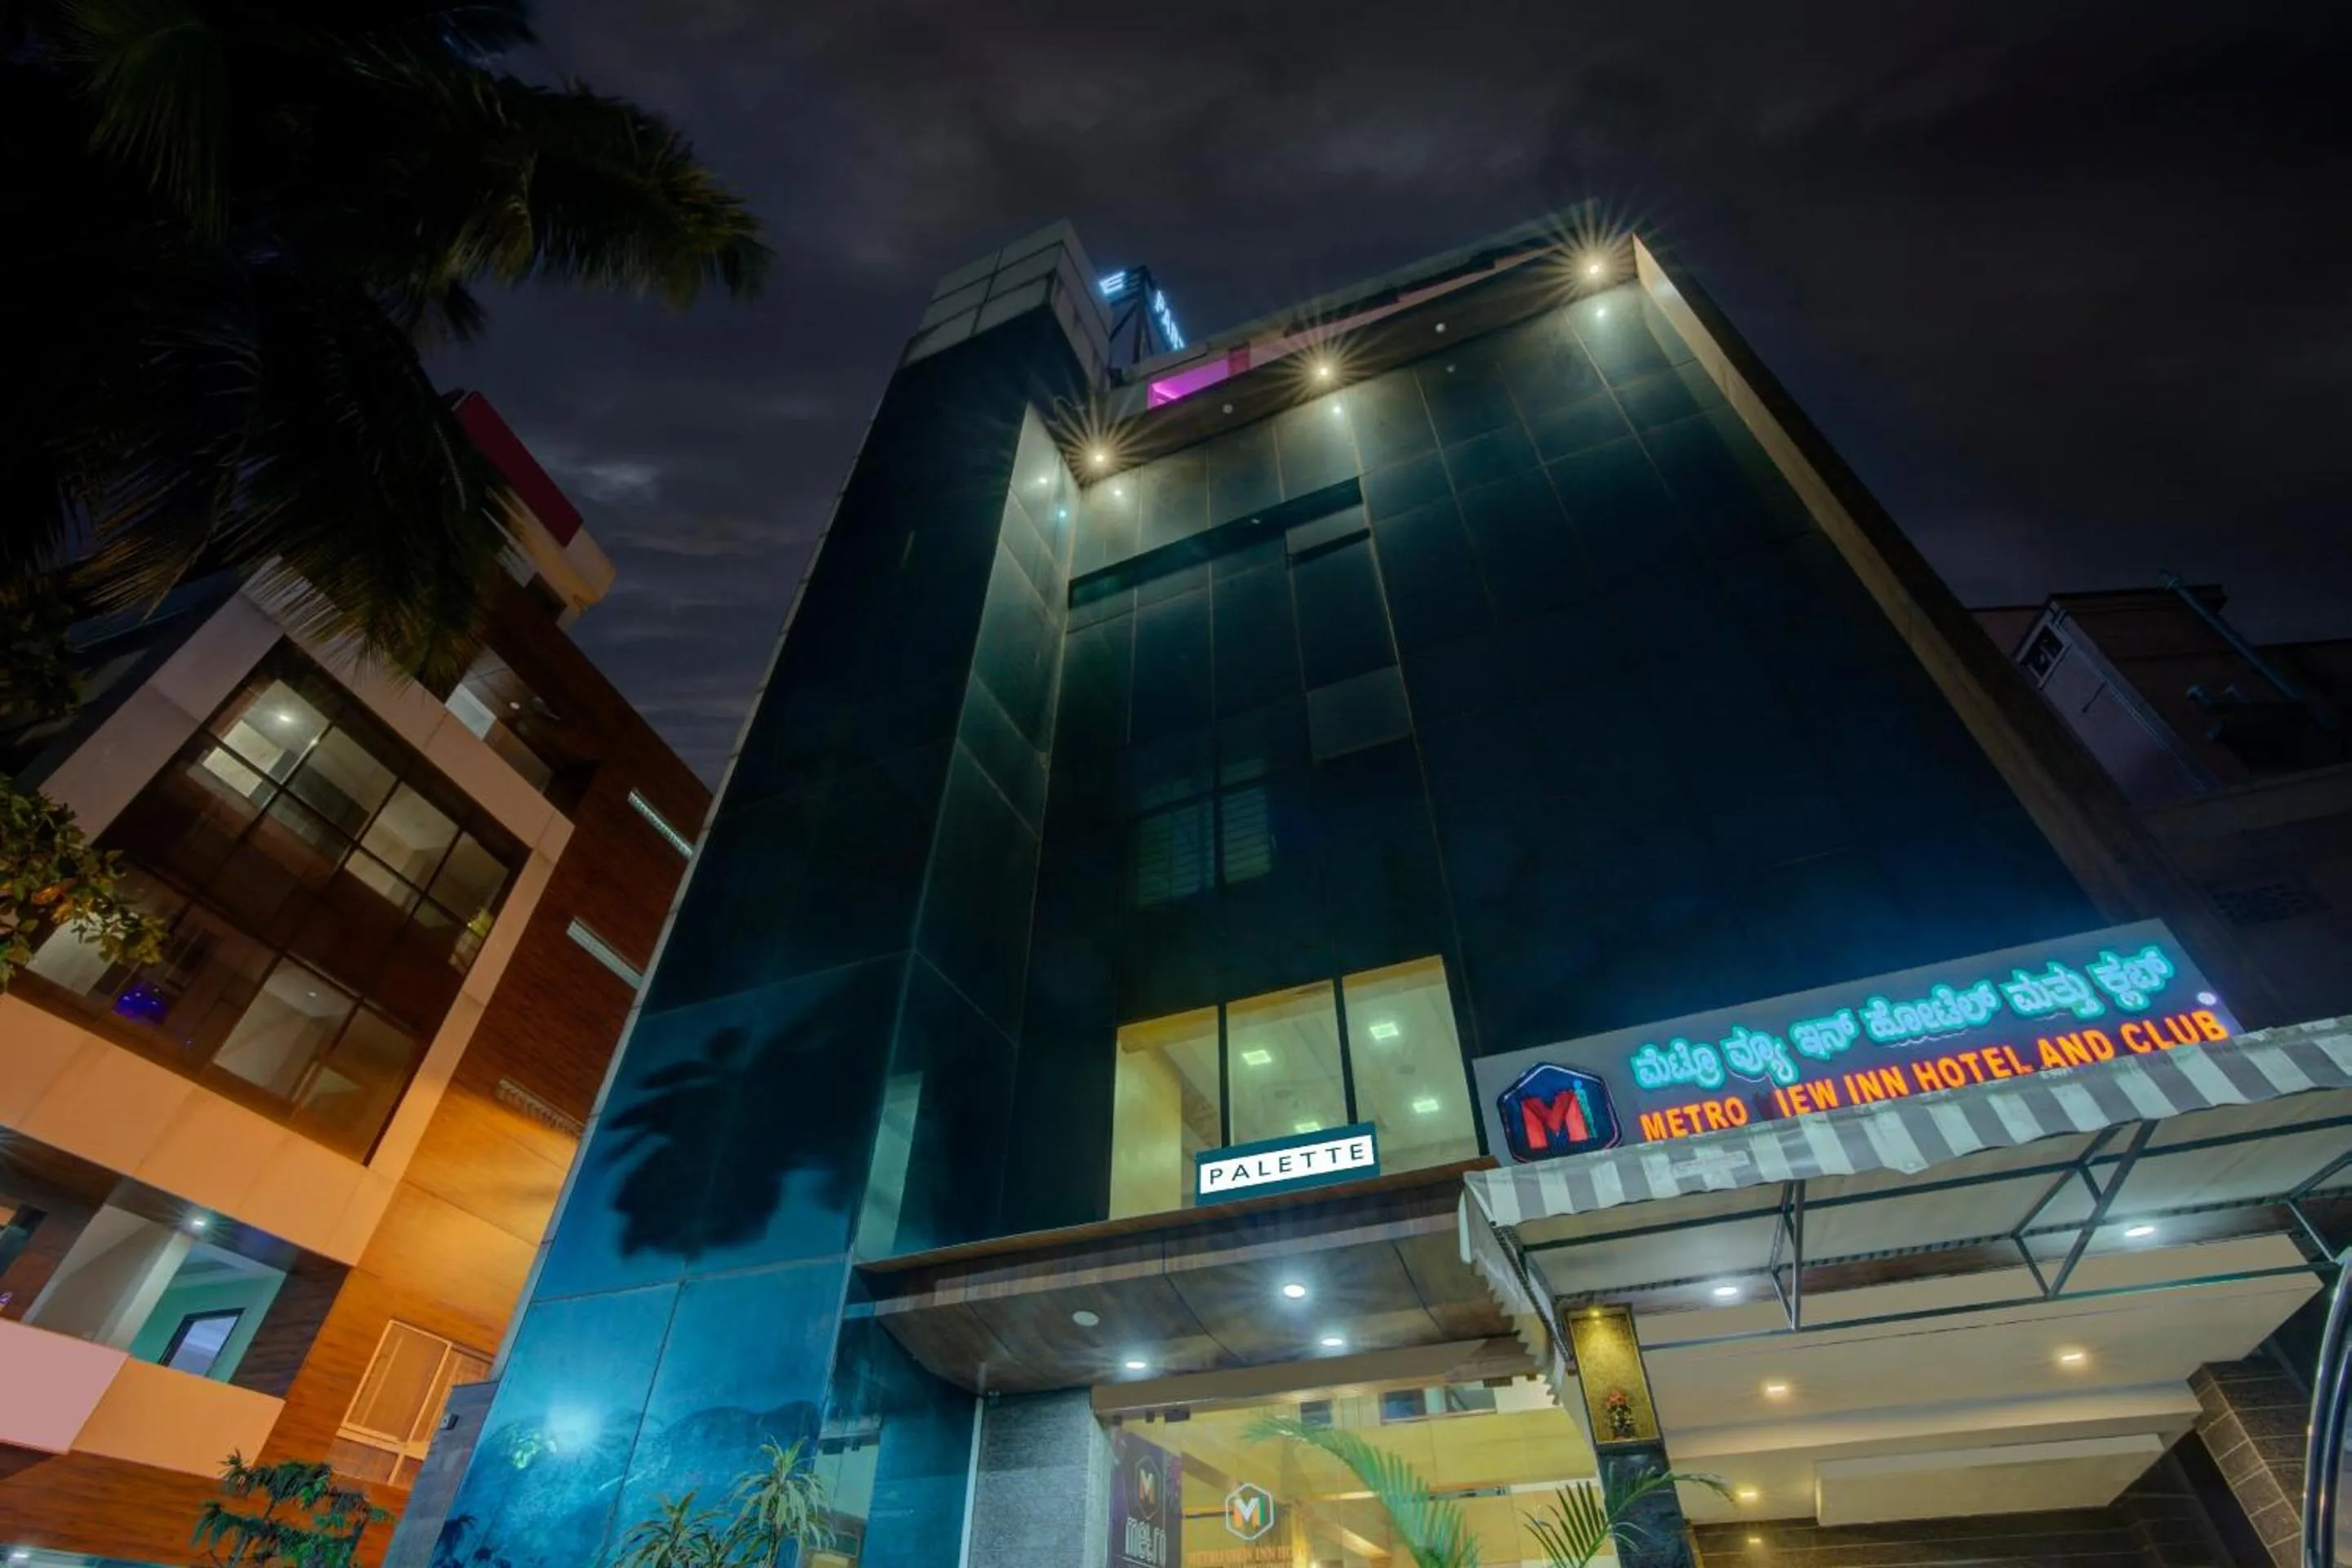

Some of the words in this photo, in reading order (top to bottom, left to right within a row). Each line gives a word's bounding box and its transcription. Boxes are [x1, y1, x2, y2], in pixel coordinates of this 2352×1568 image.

[1788, 1008, 1860, 1059] ಇನ್
[1859, 979, 2000, 1043] ಹೋಟೆಲ್
[2000, 962, 2105, 1018] ಮತ್ತು
[2086, 946, 2174, 1010] ಕ್ಲಬ್
[1639, 1097, 1748, 1142] METRO
[1844, 1067, 1909, 1105] INN
[1911, 1045, 2034, 1092] HOTEL
[2037, 1030, 2115, 1068] AND
[2120, 1010, 2229, 1054] CLUB
[1209, 1143, 1364, 1185] PALETTE
